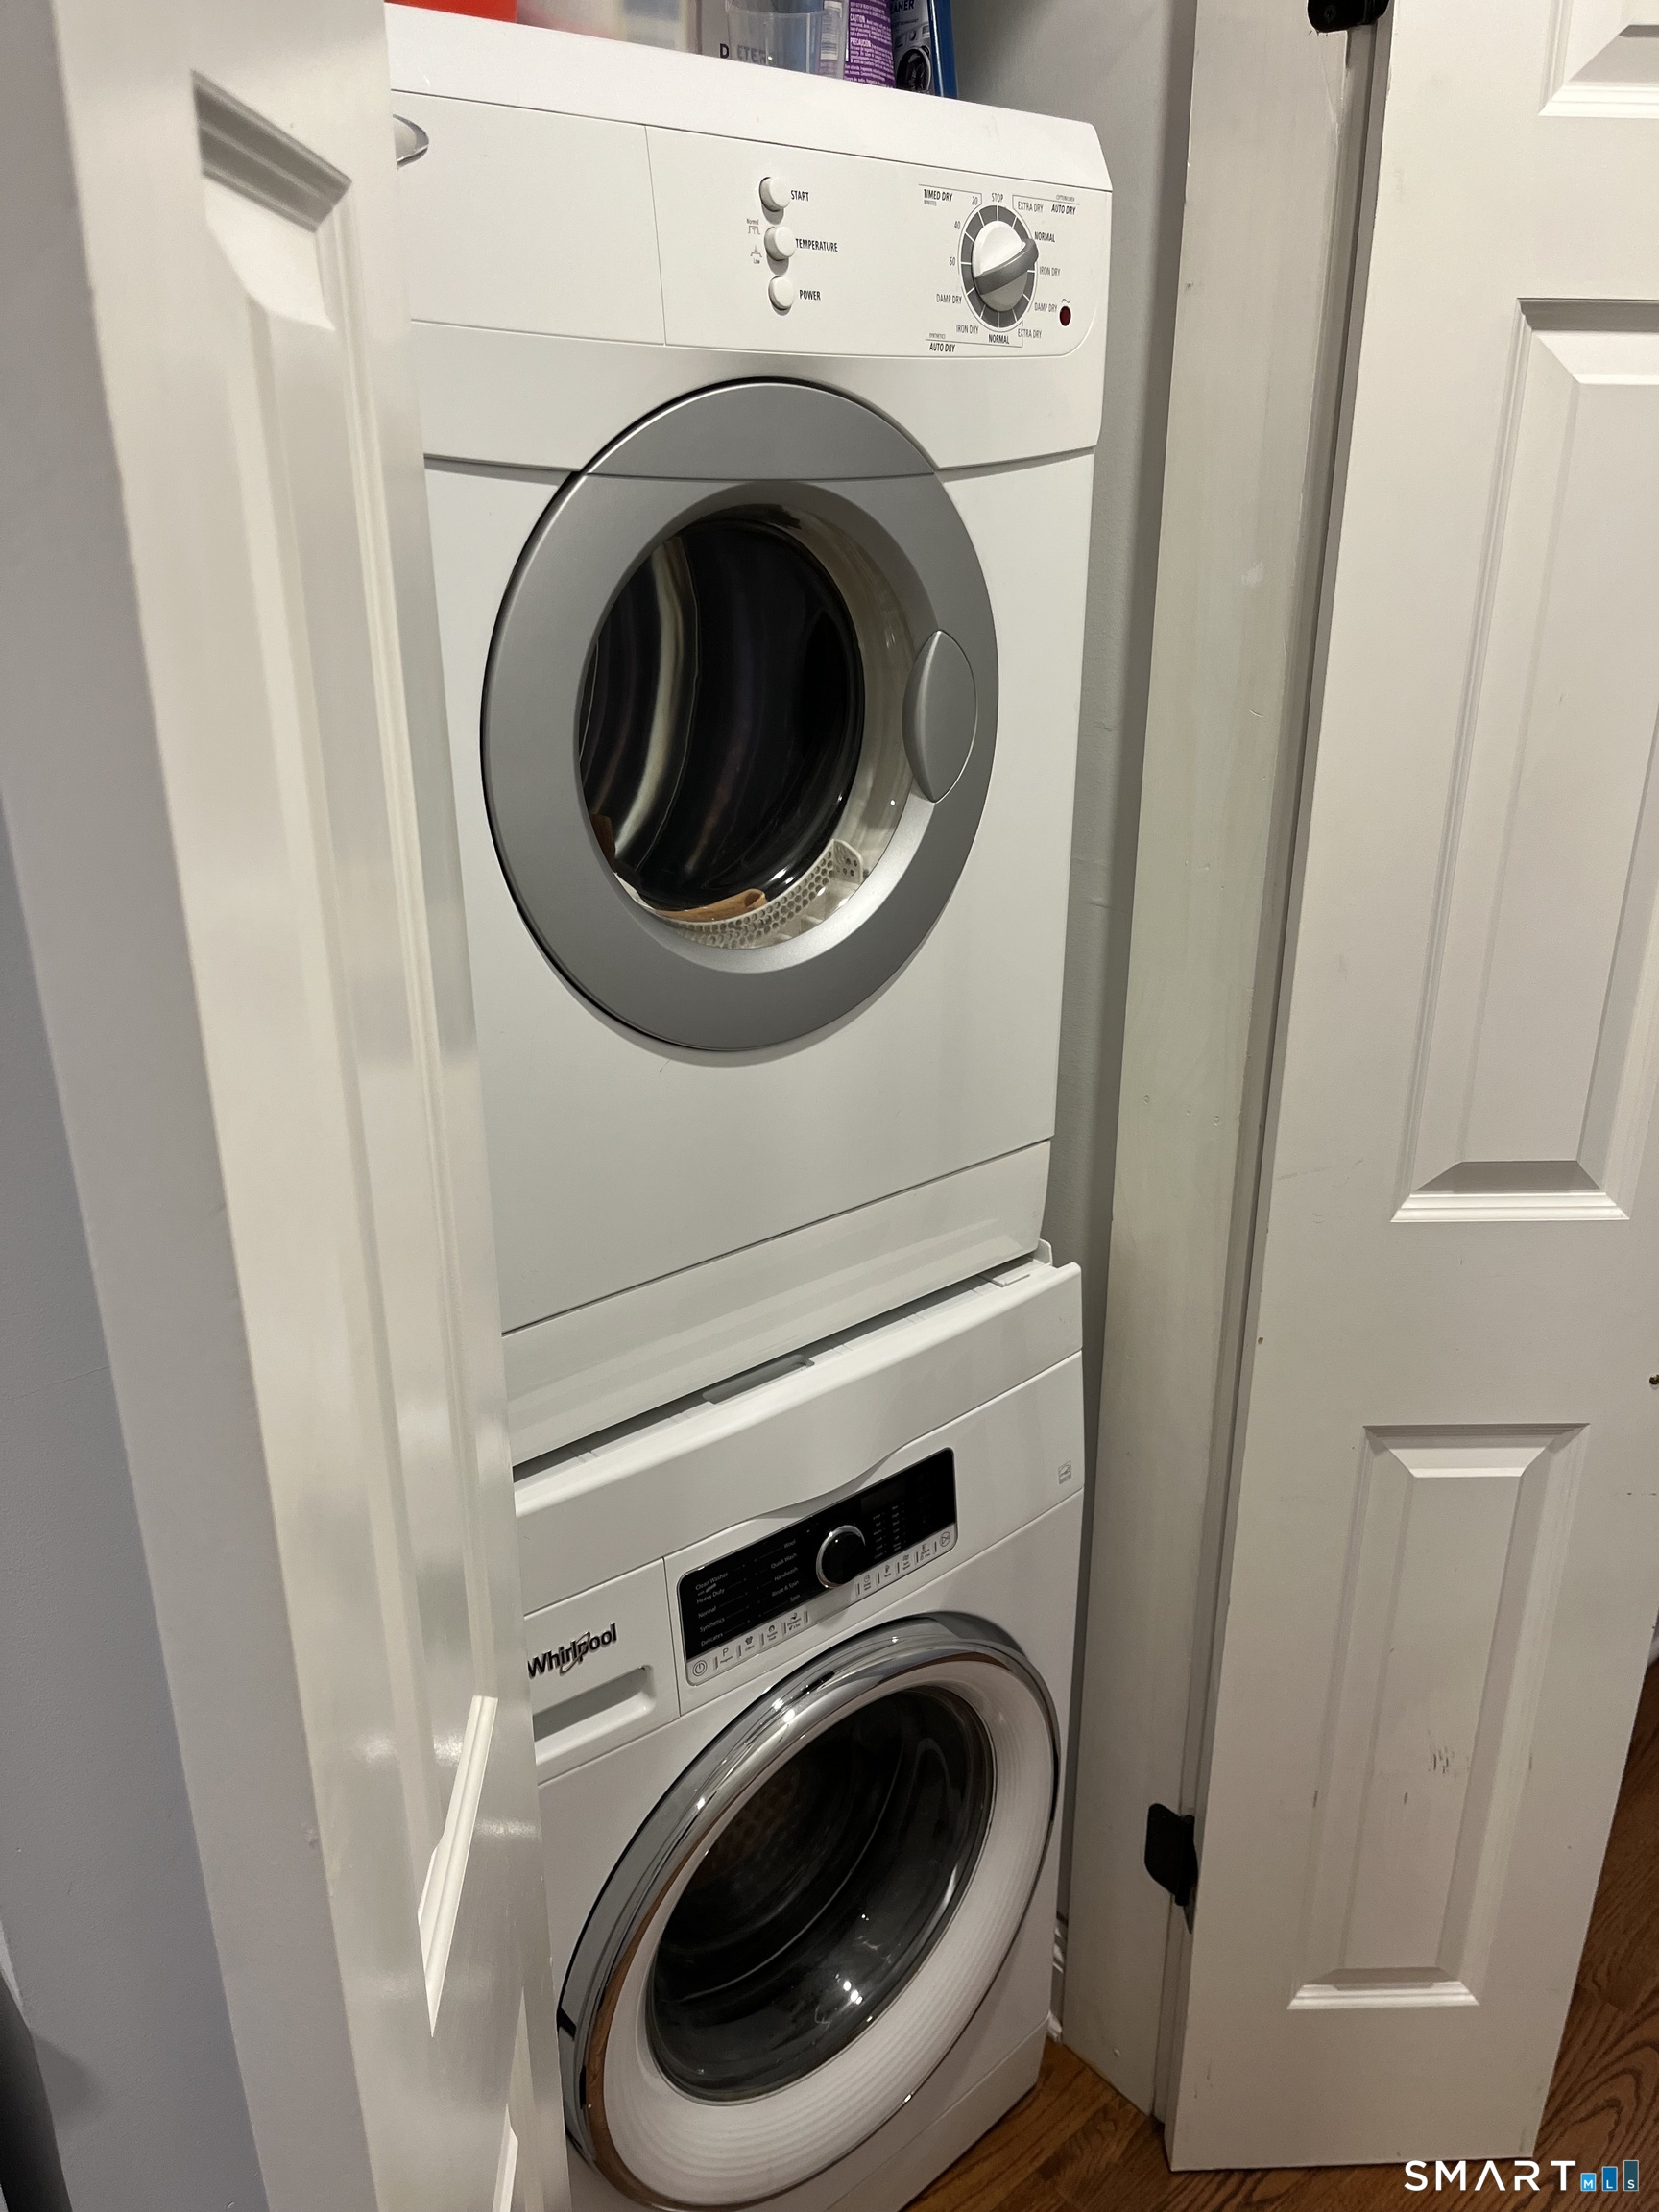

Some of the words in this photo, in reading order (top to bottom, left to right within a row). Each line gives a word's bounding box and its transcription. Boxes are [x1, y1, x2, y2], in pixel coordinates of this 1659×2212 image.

[790, 190, 809, 202] START
[924, 189, 941, 200] TIMED
[942, 192, 953, 202] DRY
[972, 197, 978, 205] 20
[992, 193, 1003, 203] STOP
[1018, 202, 1033, 212] EXTRA
[1034, 203, 1044, 213] DRY
[1051, 204, 1065, 214] AUTO
[1066, 205, 1076, 215] DRY
[954, 221, 961, 229] 40
[1034, 231, 1055, 242] NORMAL
[795, 238, 838, 252] TEMPERATURE
[949, 257, 956, 266] 60
[1039, 266, 1050, 276] IRON
[1051, 267, 1061, 276] DRY
[799, 289, 821, 301] POWER
[936, 294, 950, 304] DAMP
[951, 295, 962, 304] DRY
[1034, 302, 1048, 312] DAMP
[1048, 303, 1058, 313] DRY
[956, 325, 969, 334] IRON
[969, 325, 979, 334] DRY
[1018, 329, 1032, 338] EXTRA
[1032, 330, 1042, 339] DRY
[988, 334, 1010, 344] NORMAL
[929, 343, 944, 351] AUTO
[945, 344, 955, 352] DRY
[783, 1539, 796, 1549] Wool
[695, 1580, 710, 1590] Clean
[709, 1572, 729, 1584] Washer
[696, 1595, 712, 1605] Heavy
[712, 1588, 725, 1598] Duty
[789, 1594, 801, 1602] Spin
[698, 1605, 717, 1619] Normal
[699, 1618, 725, 1632] Synthetics
[700, 1632, 724, 1647] Delicates
[527, 1623, 617, 1678] Whirlpool
